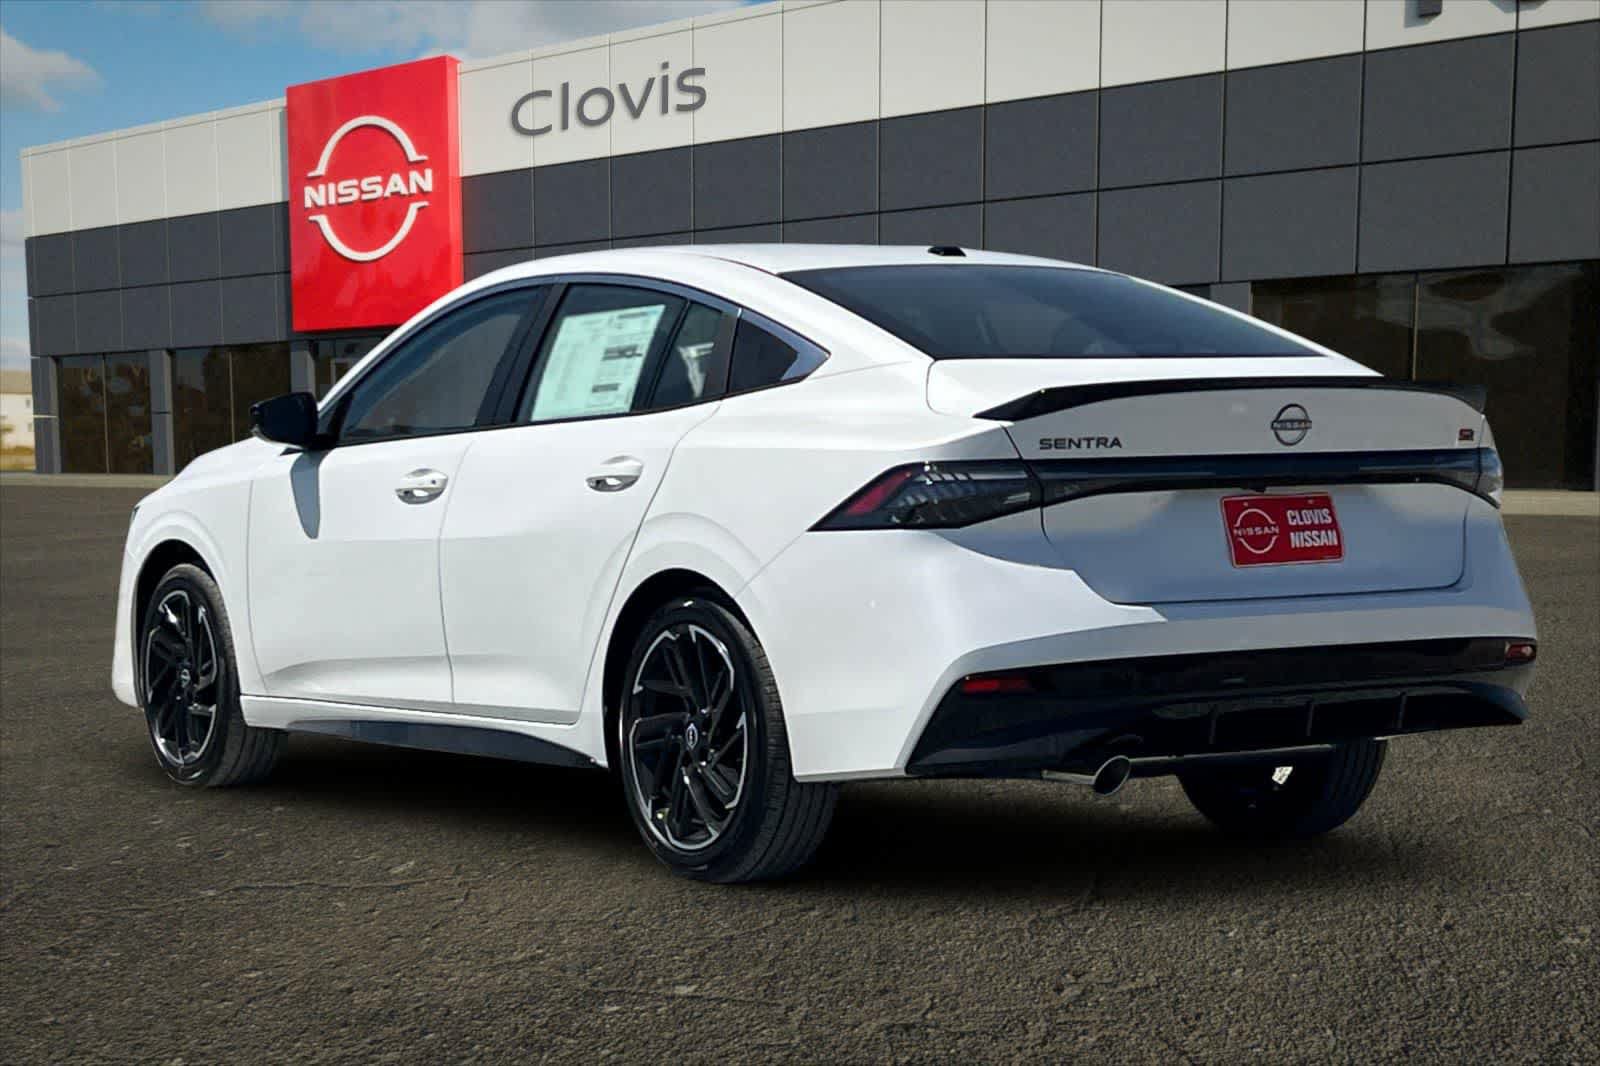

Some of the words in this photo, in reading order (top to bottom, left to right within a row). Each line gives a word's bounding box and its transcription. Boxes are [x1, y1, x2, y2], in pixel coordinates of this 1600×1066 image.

[511, 62, 707, 136] Clovis
[304, 168, 433, 209] NISSAN
[1039, 436, 1123, 450] SENTRA
[1287, 508, 1332, 526] CLOVIS
[1233, 525, 1279, 536] NISSAN
[1290, 529, 1338, 549] NISSAN
